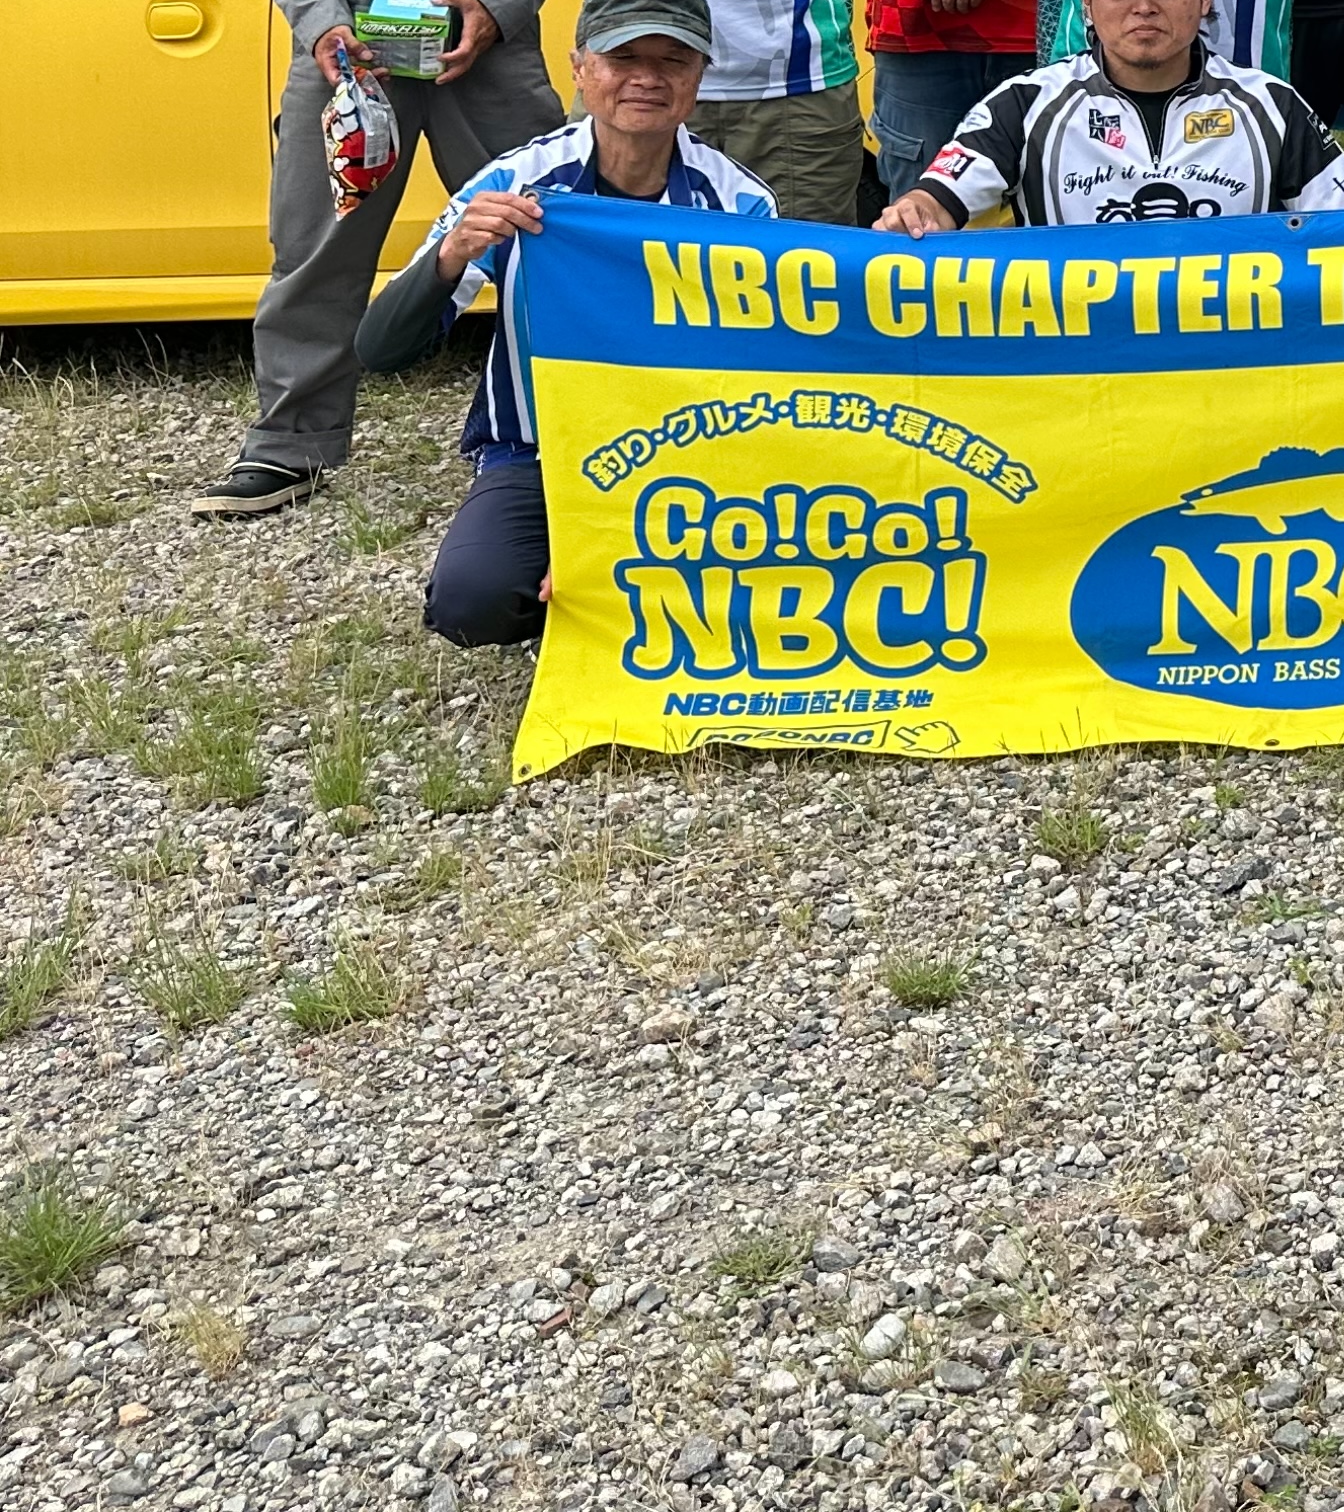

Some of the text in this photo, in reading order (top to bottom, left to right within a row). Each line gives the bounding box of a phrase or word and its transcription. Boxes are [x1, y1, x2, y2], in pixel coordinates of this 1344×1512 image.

[1190, 115, 1230, 136] NBC
[1063, 167, 1115, 196] Fight
[1121, 165, 1136, 180] it
[1181, 164, 1250, 197] Fishing
[642, 239, 841, 336] NBC
[864, 251, 1285, 338] CHAPTER
[581, 389, 1039, 504] 釣り・グルメ・観光・環境保全
[637, 479, 970, 562] Go!Go!
[617, 556, 985, 678] NBC!
[1157, 662, 1260, 686] NIPPON
[1273, 658, 1341, 682] BASS
[663, 689, 934, 716] NBC動画配信基地
